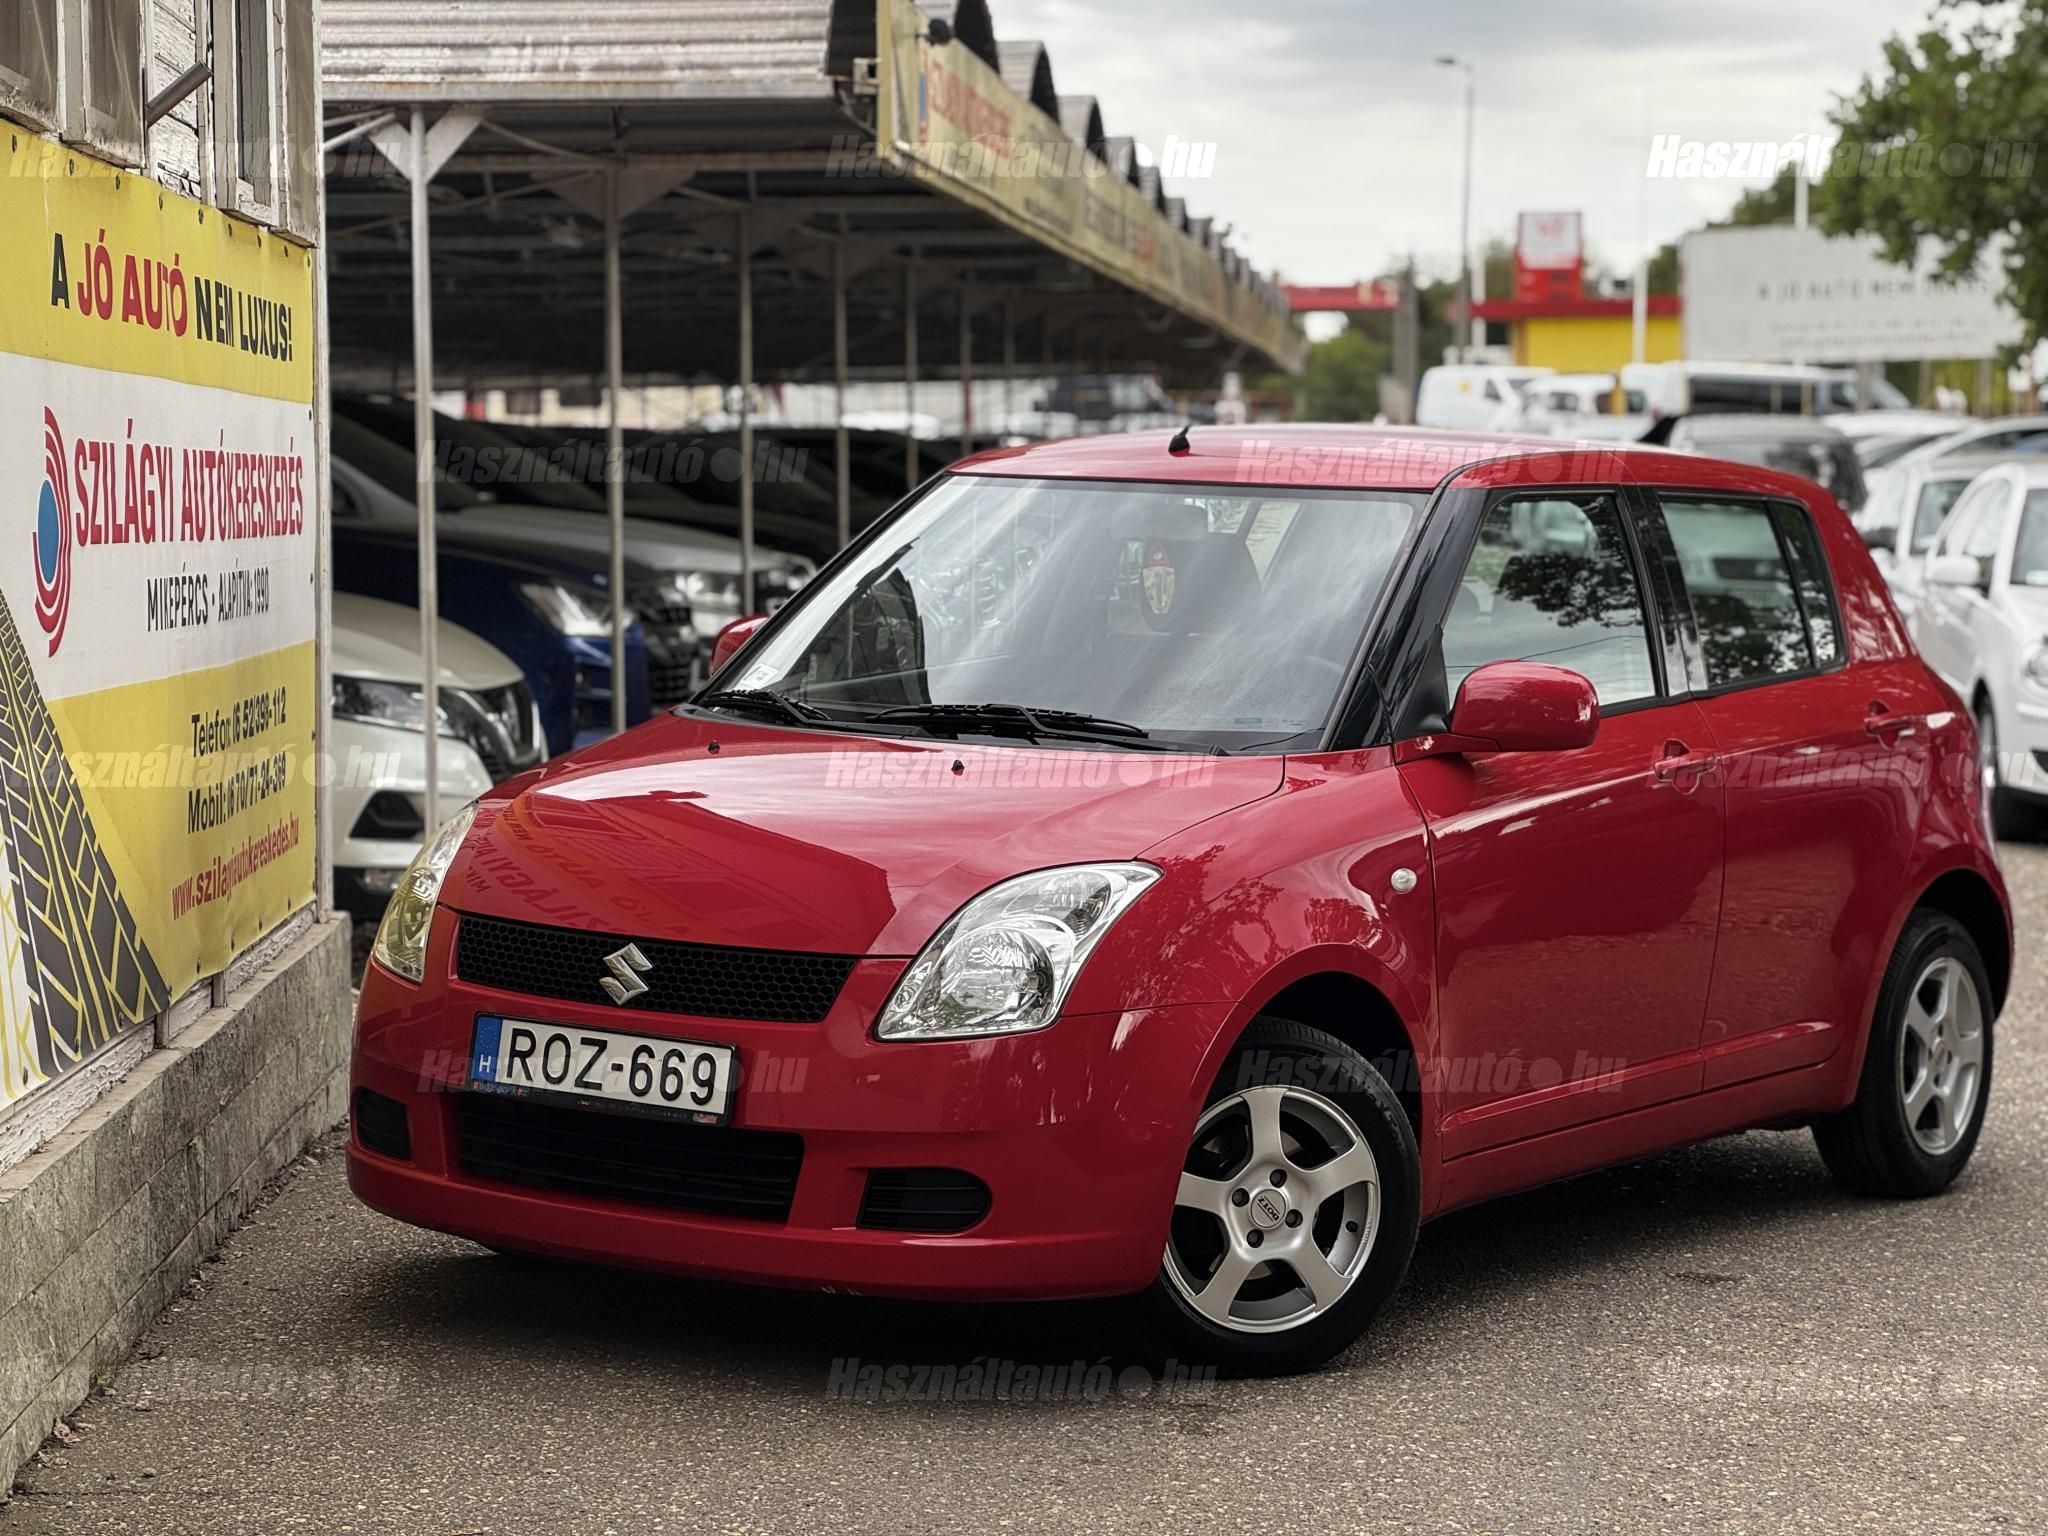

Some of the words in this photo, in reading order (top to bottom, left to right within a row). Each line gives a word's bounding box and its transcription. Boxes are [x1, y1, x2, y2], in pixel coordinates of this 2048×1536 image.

[51, 232, 70, 309] A
[77, 228, 113, 320] JÓ
[121, 253, 188, 337] AUTÓ
[194, 276, 234, 348] NEM
[238, 291, 293, 362] LUXUS!
[74, 418, 174, 547] SZILÁGYI
[181, 428, 303, 542] AUTÓKERESKEDÉS
[146, 561, 209, 632] MIKEPÉRCS
[218, 557, 253, 622] ALAPÍTVA:
[254, 566, 270, 615] 1990
[188, 782, 226, 834] Mobil:
[478, 1054, 492, 1073] H
[506, 1027, 717, 1106] ROZ-669
[1257, 1197, 1280, 1221] DOTZ
